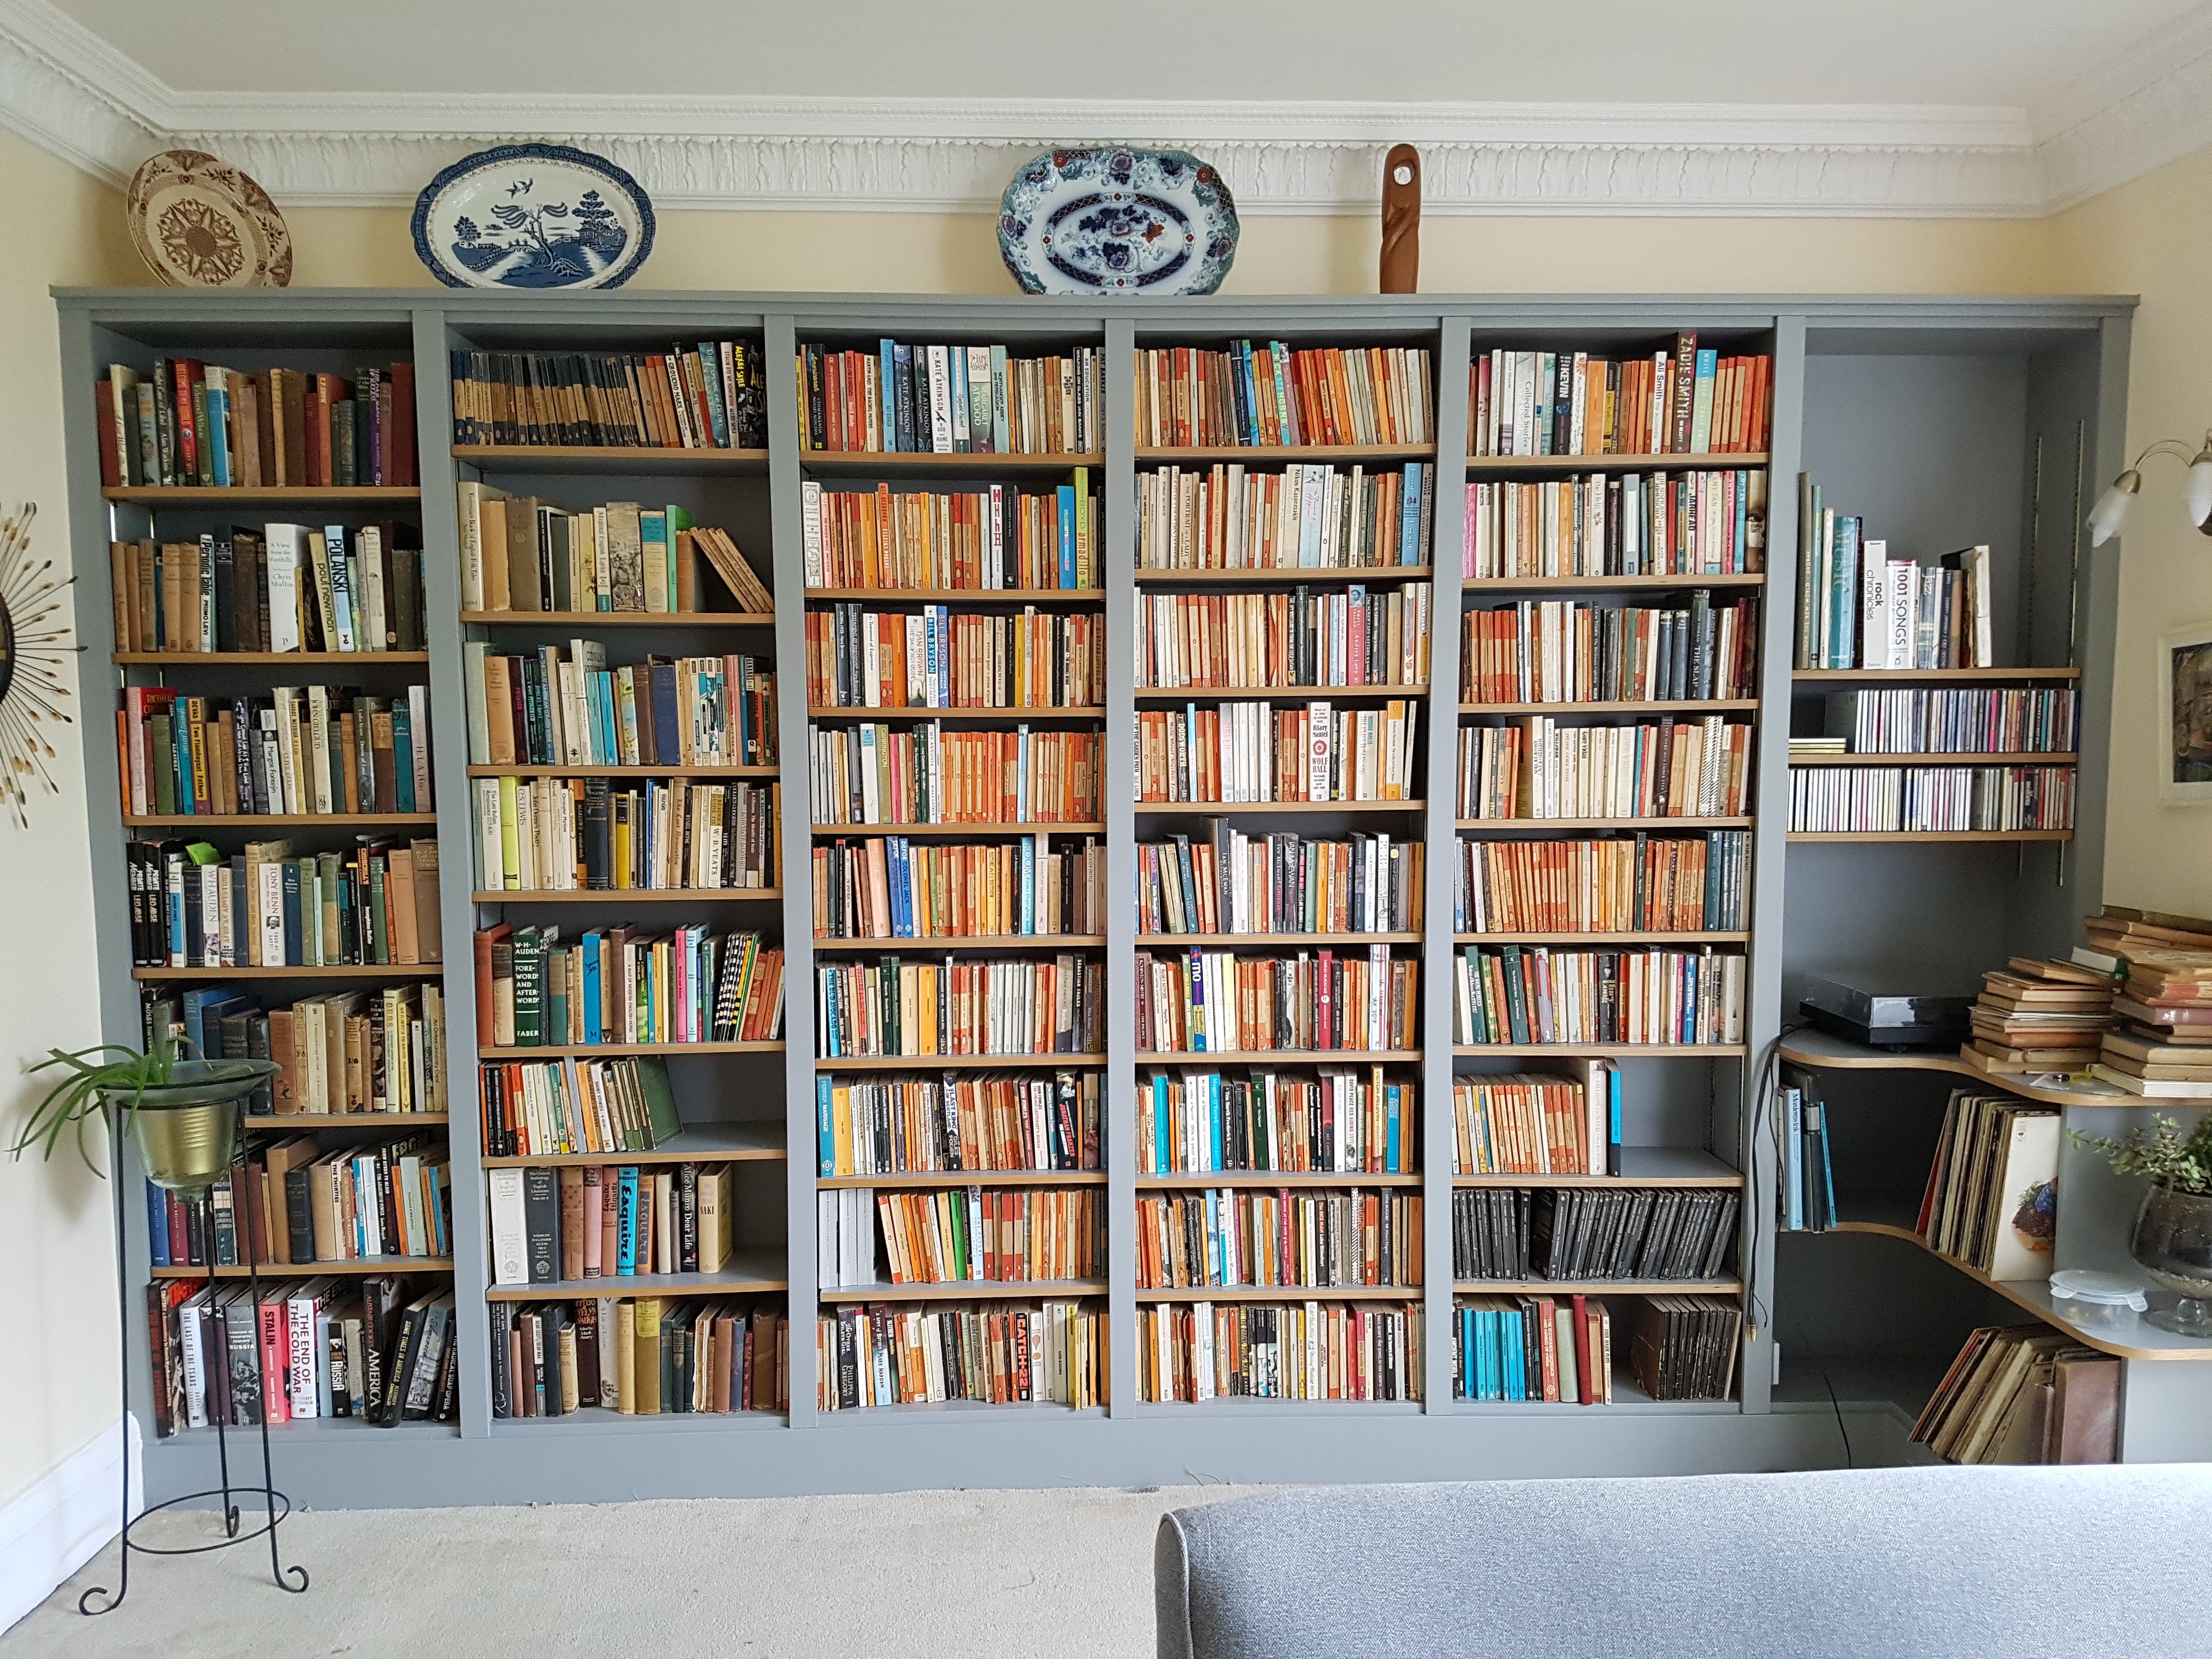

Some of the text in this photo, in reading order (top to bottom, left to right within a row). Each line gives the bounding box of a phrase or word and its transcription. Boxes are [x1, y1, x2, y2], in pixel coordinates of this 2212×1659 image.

[735, 346, 744, 369] ALEXEI
[1679, 337, 1692, 373] ZADIE
[668, 362, 681, 409] GROUCHO MARX
[934, 360, 944, 410] KATE ATKINSON
[1077, 374, 1082, 382] ON
[1560, 368, 1568, 397] KEVIN
[1655, 375, 1663, 400] Smith
[972, 386, 981, 426] ATWOOD
[1277, 392, 1288, 430] HORNBY
[1678, 376, 1692, 418] SMITH
[1292, 488, 1300, 520] Kazantzakis
[201, 542, 211, 574] Periodic
[328, 539, 346, 592] POLANSKI
[201, 577, 211, 595] Table
[318, 563, 335, 633] paul newman
[1866, 570, 1875, 620] chronicles
[1875, 583, 1883, 606] rock
[1922, 574, 1934, 595] Jazz
[1895, 568, 1907, 645] 1001 SONGS
[311, 699, 319, 721] JOHN
[194, 740, 202, 772] Flamboyant
[1178, 723, 1187, 767] DODSWORTH
[267, 746, 278, 793] Margot Fonteyn
[196, 775, 205, 798] Fathers
[712, 828, 719, 838] W.
[712, 840, 719, 849] B.
[270, 892, 279, 913] BENN
[1193, 962, 1202, 981] mo
[683, 1165, 691, 1184] Alice
[683, 1185, 692, 1210] Munro
[700, 1206, 714, 1215] SAKI
[621, 1185, 631, 1260] Esquire
[639, 1198, 650, 1256] Esquire
[184, 1327, 192, 1340] LAST
[265, 1311, 275, 1345] STALIN
[401, 1336, 409, 1352] TIMES
[404, 1321, 412, 1335] SOME
[290, 1305, 301, 1393] THE COLD WAR
[300, 1313, 311, 1384] THE END OF
[1017, 1319, 1028, 1386] CATCH-22
[187, 1368, 195, 1386] TSARS
[369, 1348, 381, 1407] AMERICA
[393, 1359, 405, 1383] AMERICA
